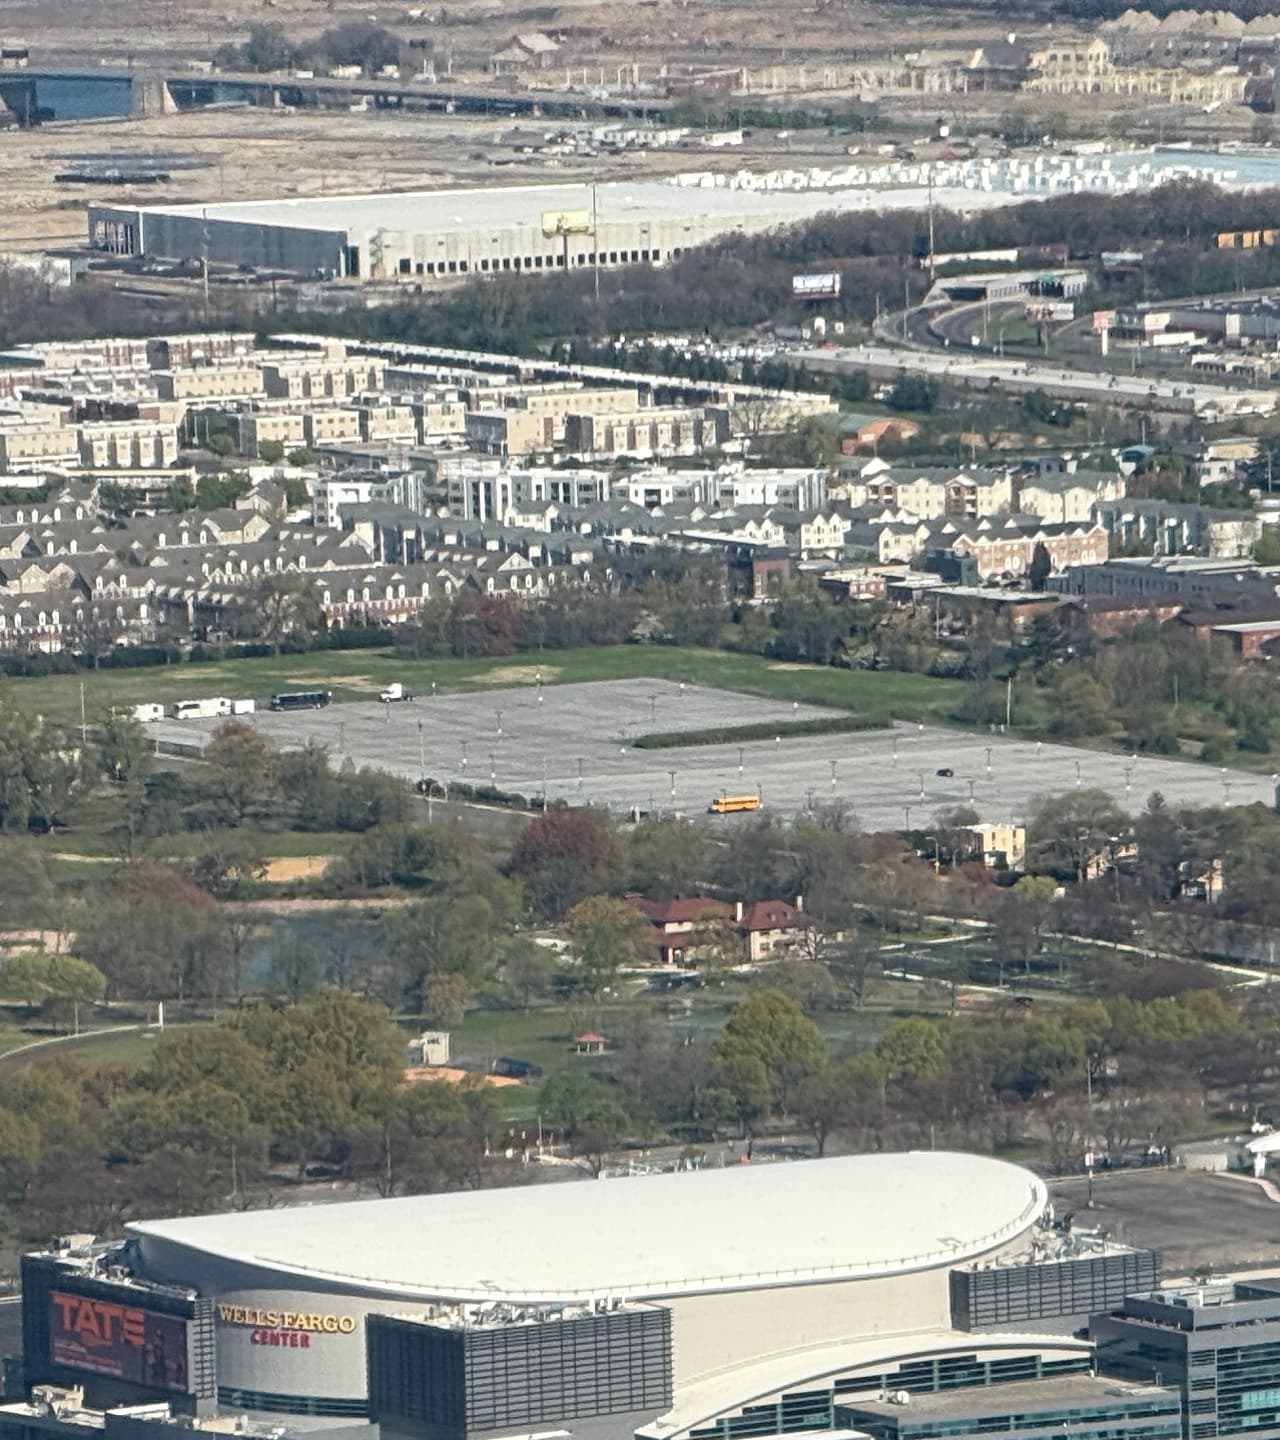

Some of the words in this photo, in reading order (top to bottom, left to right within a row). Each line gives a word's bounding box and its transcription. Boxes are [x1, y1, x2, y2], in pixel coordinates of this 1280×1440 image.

[53, 1294, 145, 1348] TATE
[218, 1303, 280, 1328] WELLS
[282, 1311, 356, 1334] FARGO
[250, 1329, 310, 1348] CENTER
